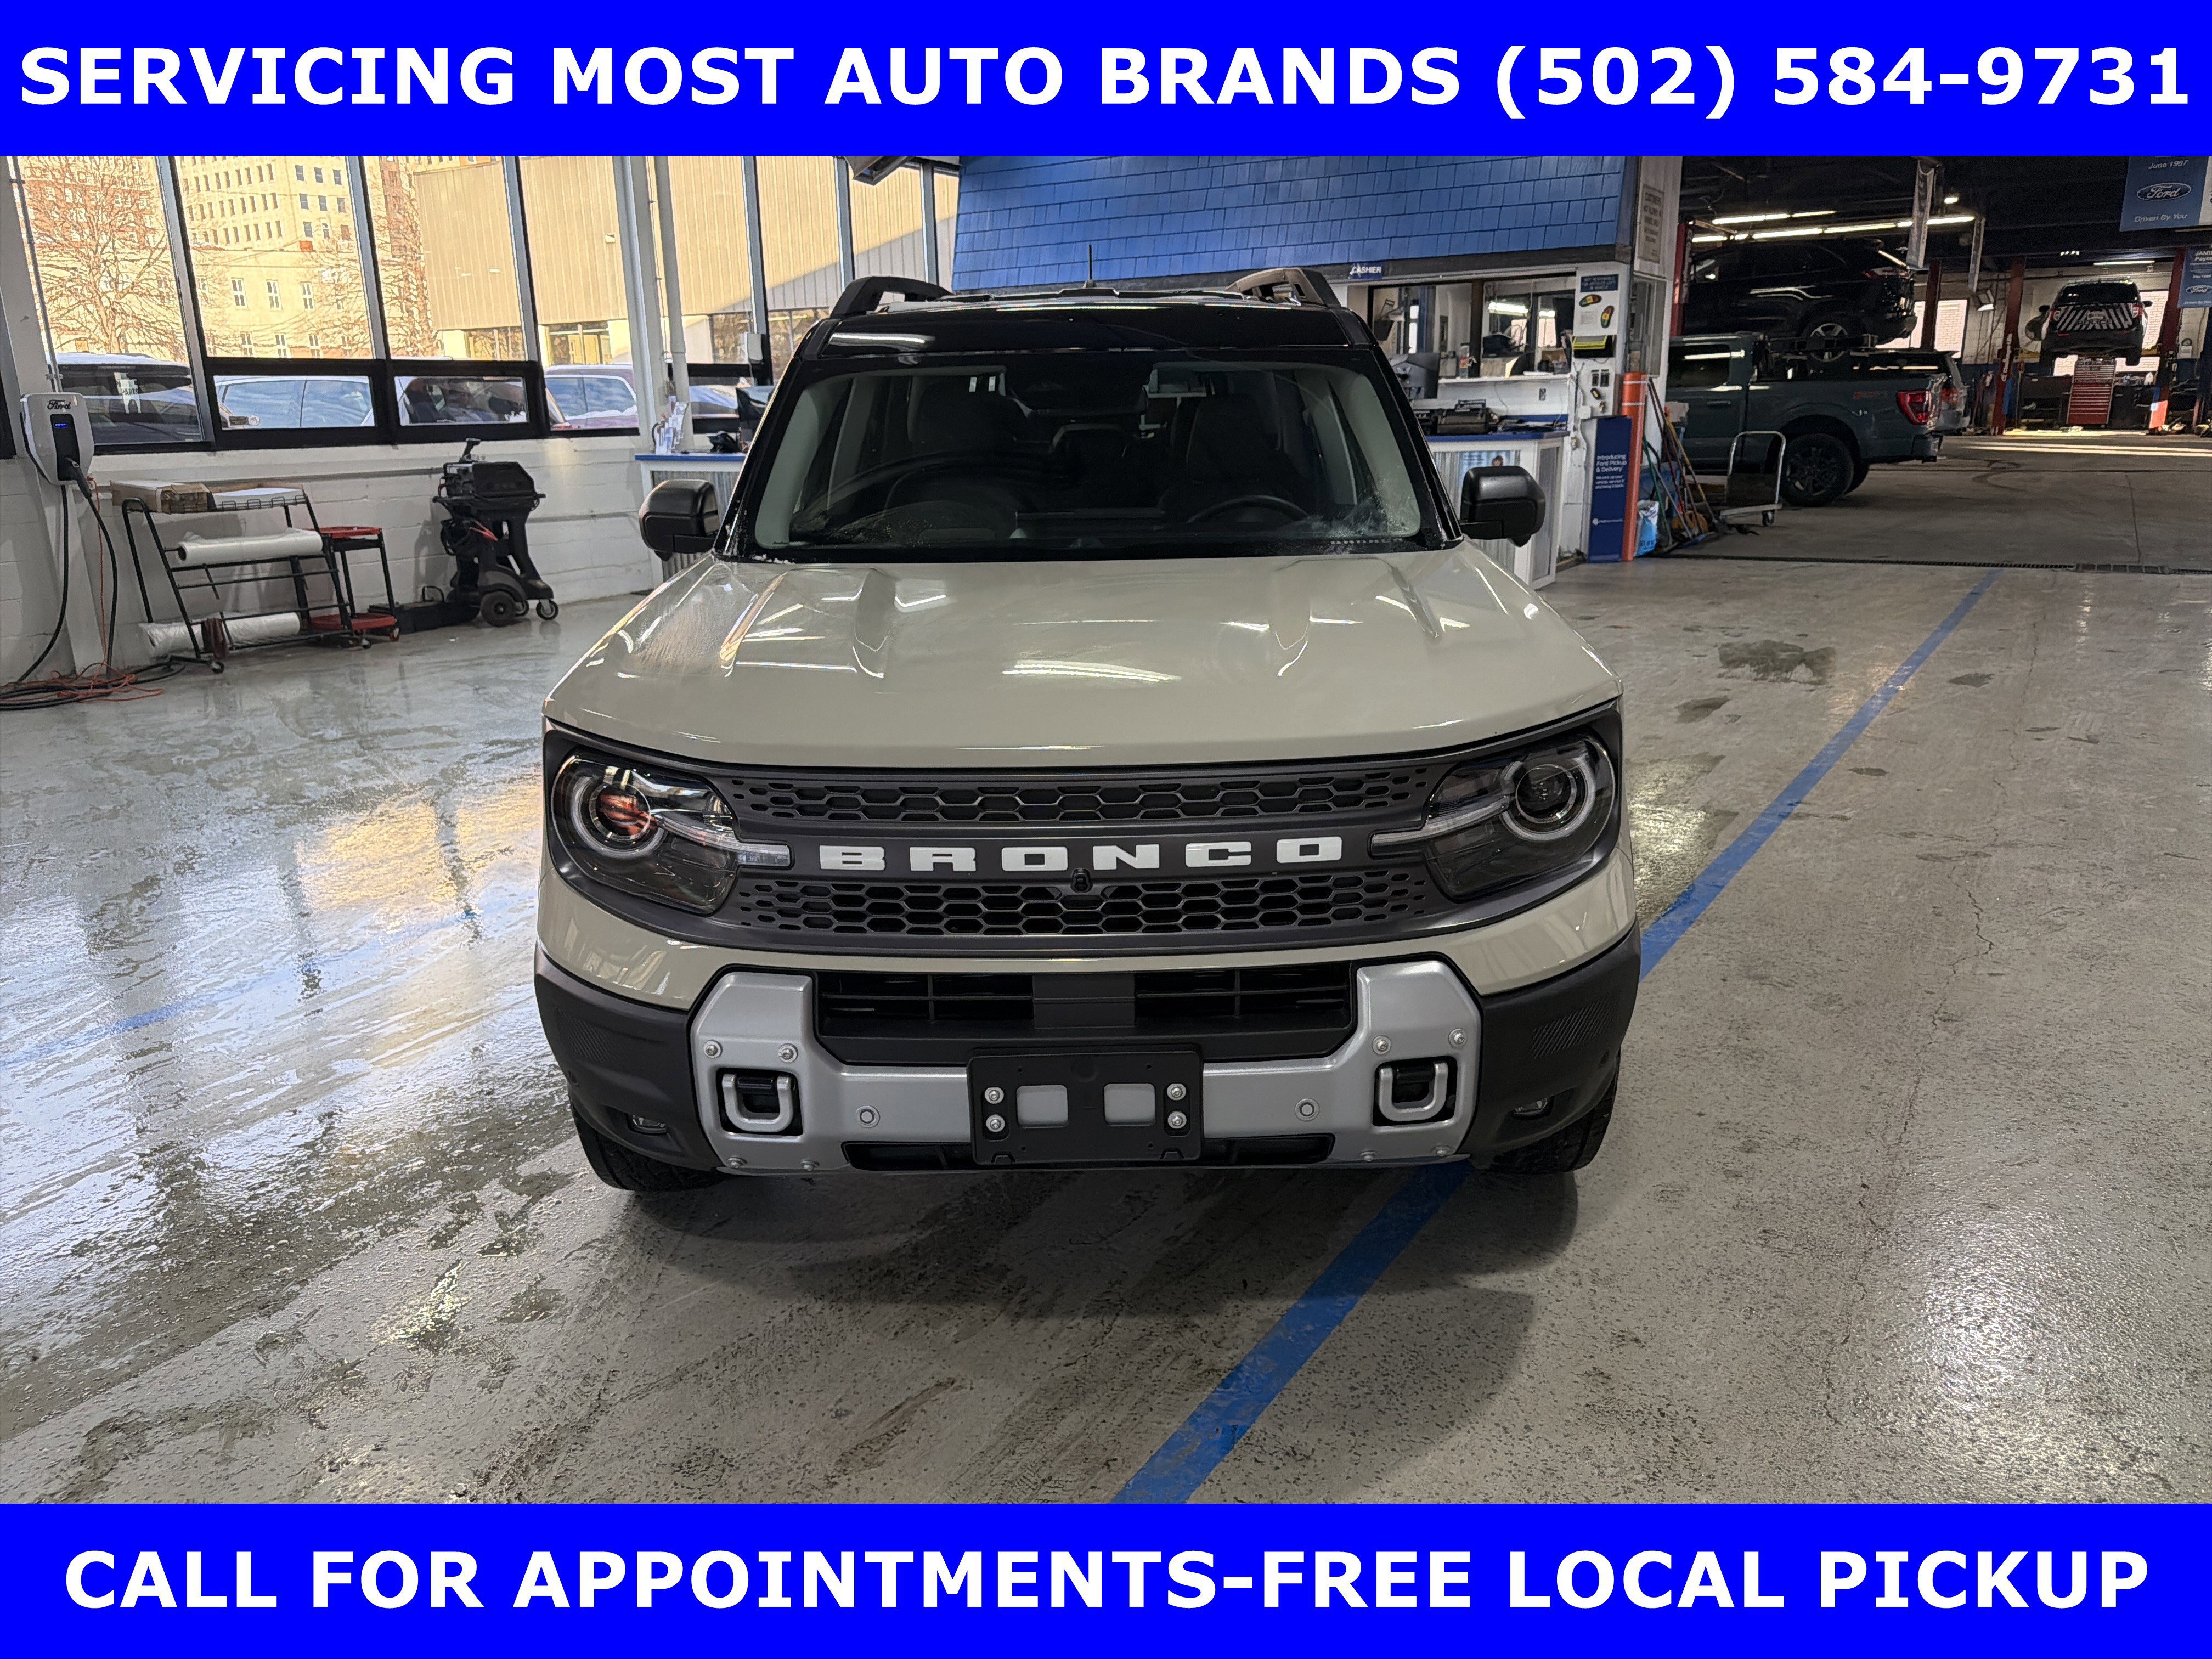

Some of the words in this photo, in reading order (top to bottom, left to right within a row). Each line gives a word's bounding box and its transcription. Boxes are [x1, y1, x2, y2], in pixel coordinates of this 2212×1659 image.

[2146, 185, 2181, 199] Ford
[1351, 266, 1382, 274] CASHIER
[47, 399, 71, 410] Ford
[819, 836, 1342, 872] BRONCO
